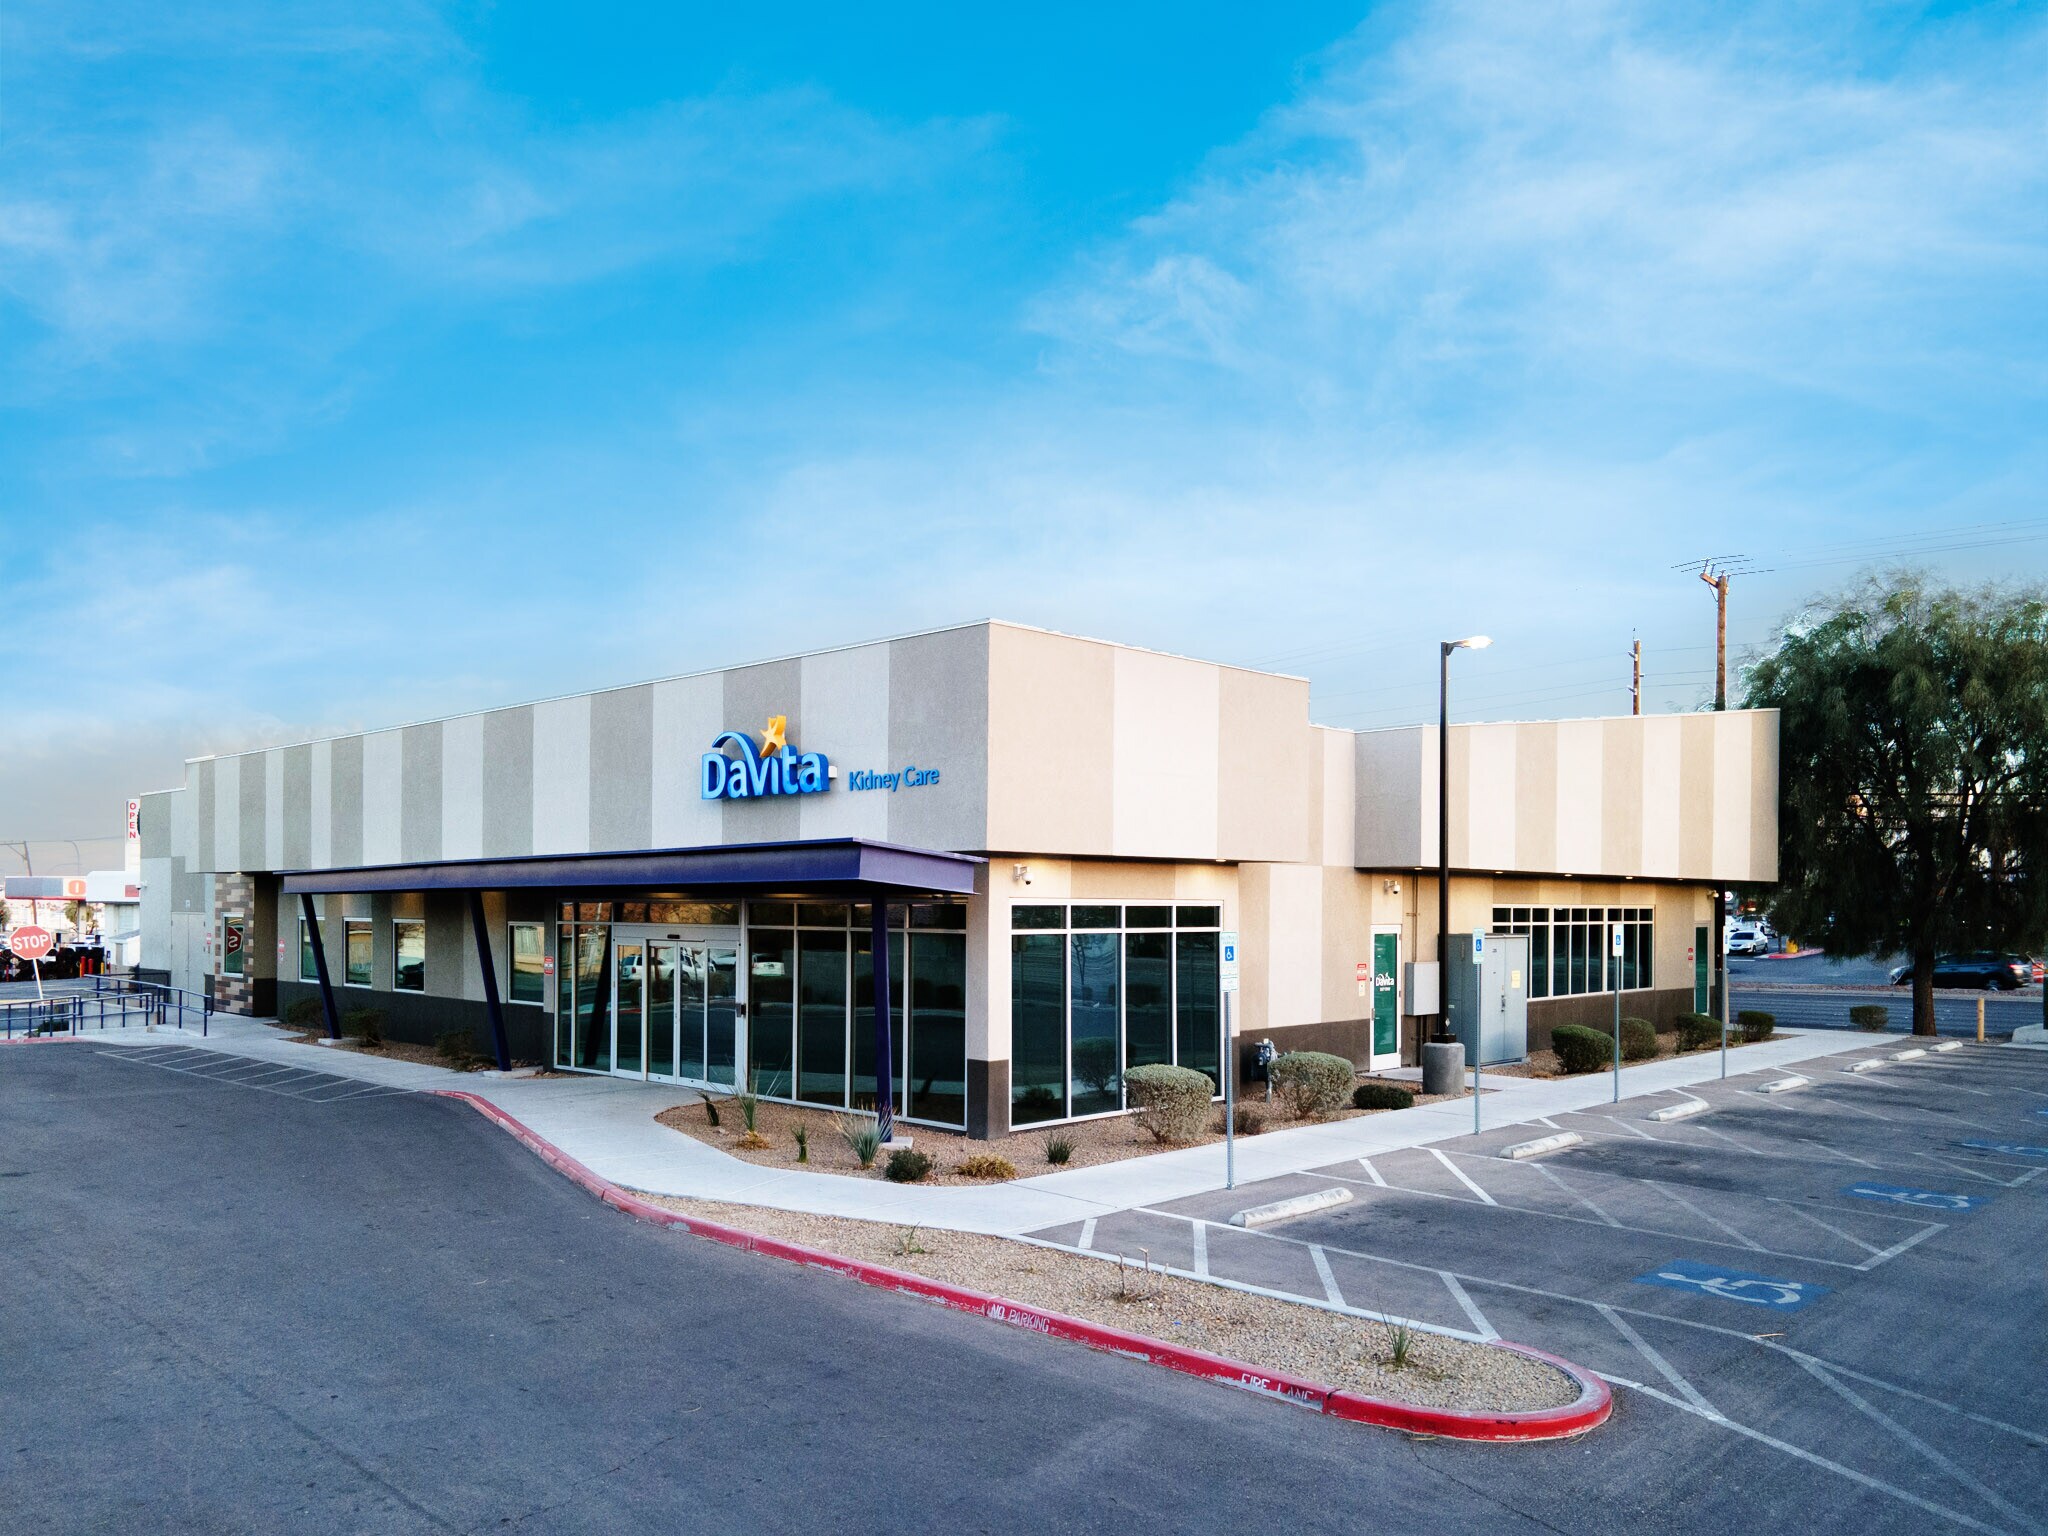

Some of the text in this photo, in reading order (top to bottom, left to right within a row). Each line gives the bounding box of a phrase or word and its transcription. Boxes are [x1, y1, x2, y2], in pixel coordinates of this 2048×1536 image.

[702, 732, 830, 800] DaVita
[849, 766, 940, 792] Kidney Care
[129, 802, 137, 839] OPEN
[13, 934, 49, 951] STOP
[991, 1304, 1050, 1333] NO PARKING
[1241, 1373, 1271, 1389] FIRE
